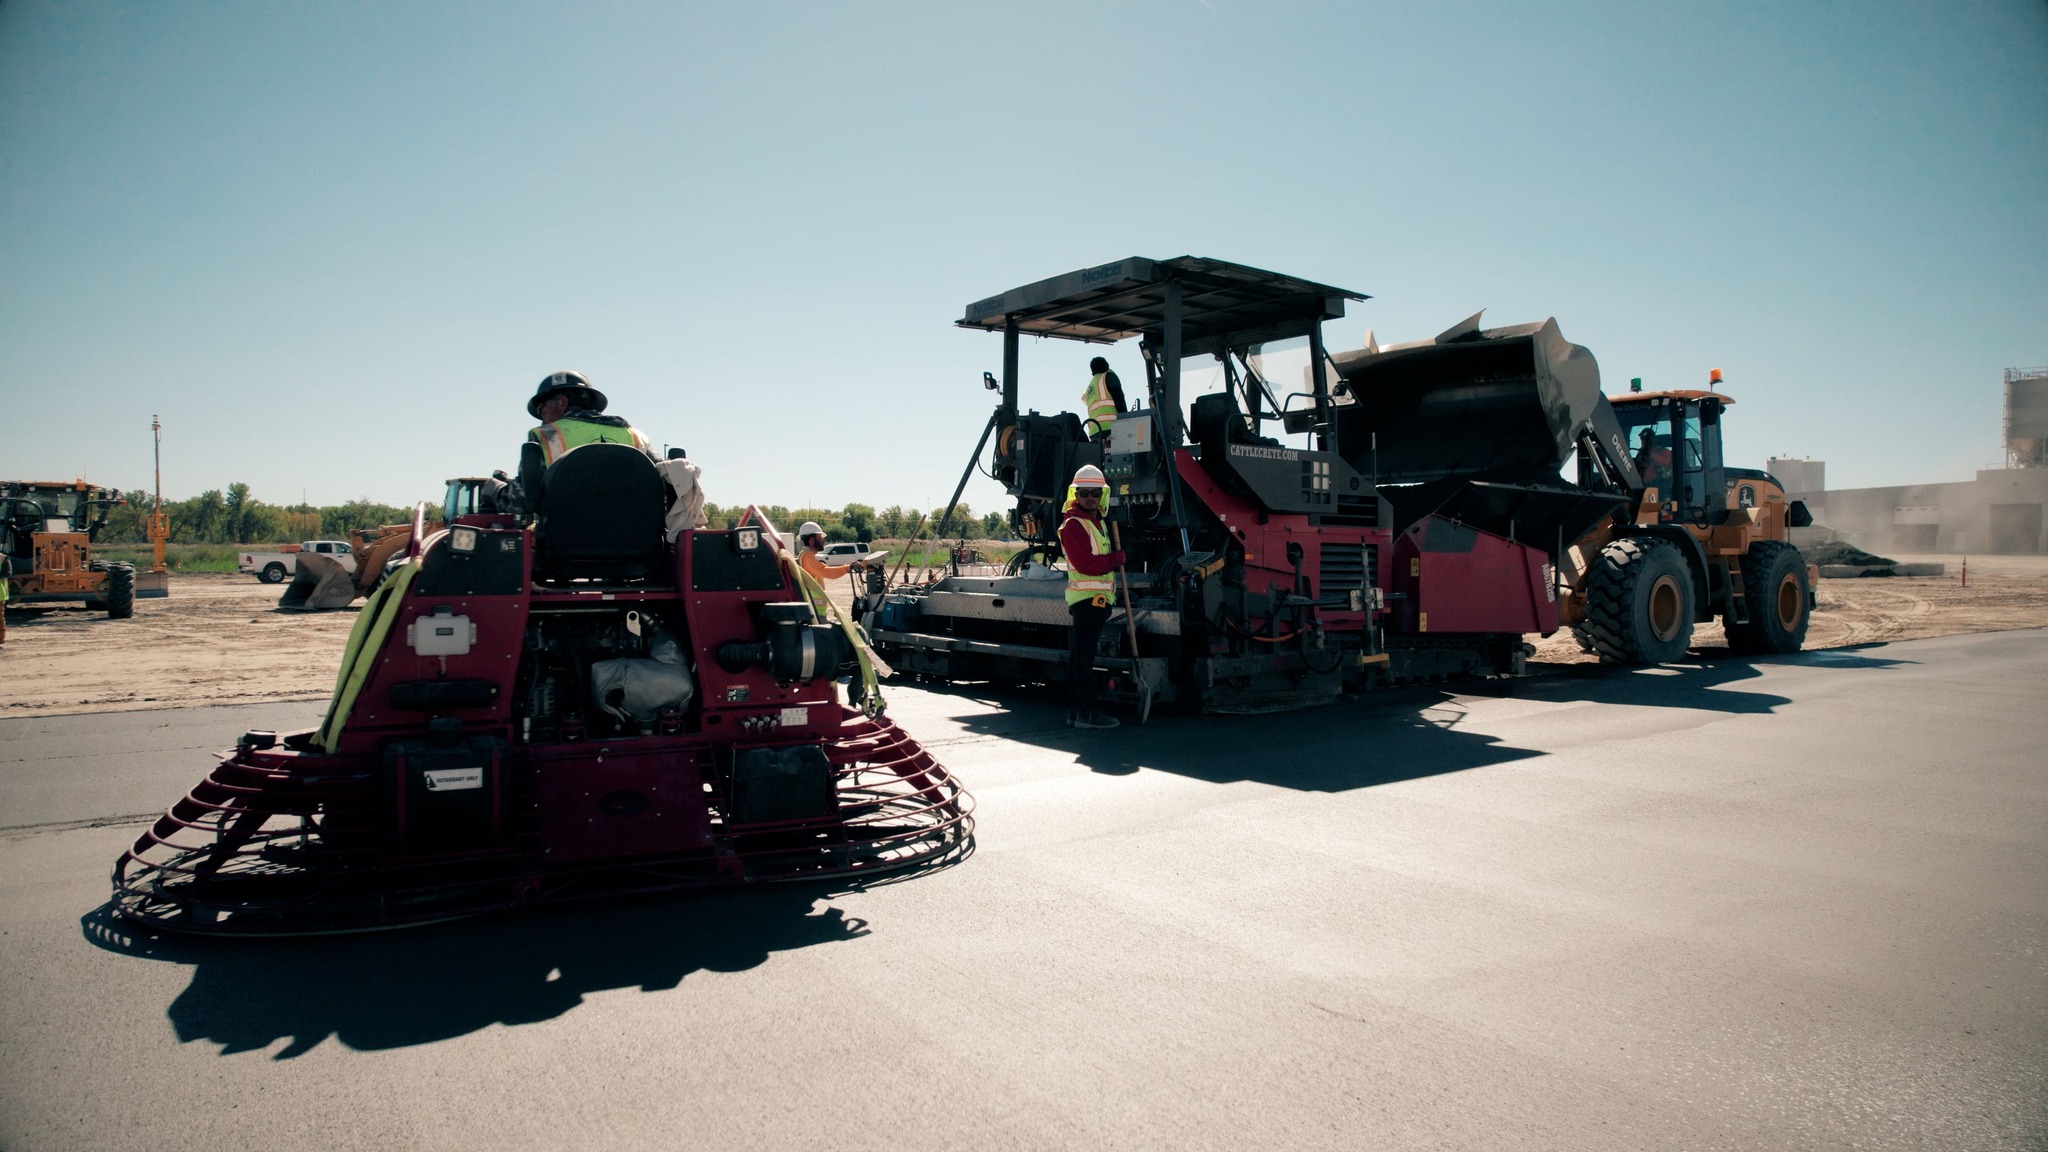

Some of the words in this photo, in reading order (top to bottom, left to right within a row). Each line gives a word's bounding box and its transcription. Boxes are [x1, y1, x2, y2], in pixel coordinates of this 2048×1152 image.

[1230, 445, 1299, 461] CATTLECRETE.COM
[1611, 433, 1632, 473] DEERE
[1541, 563, 1556, 603] ABG7820B
